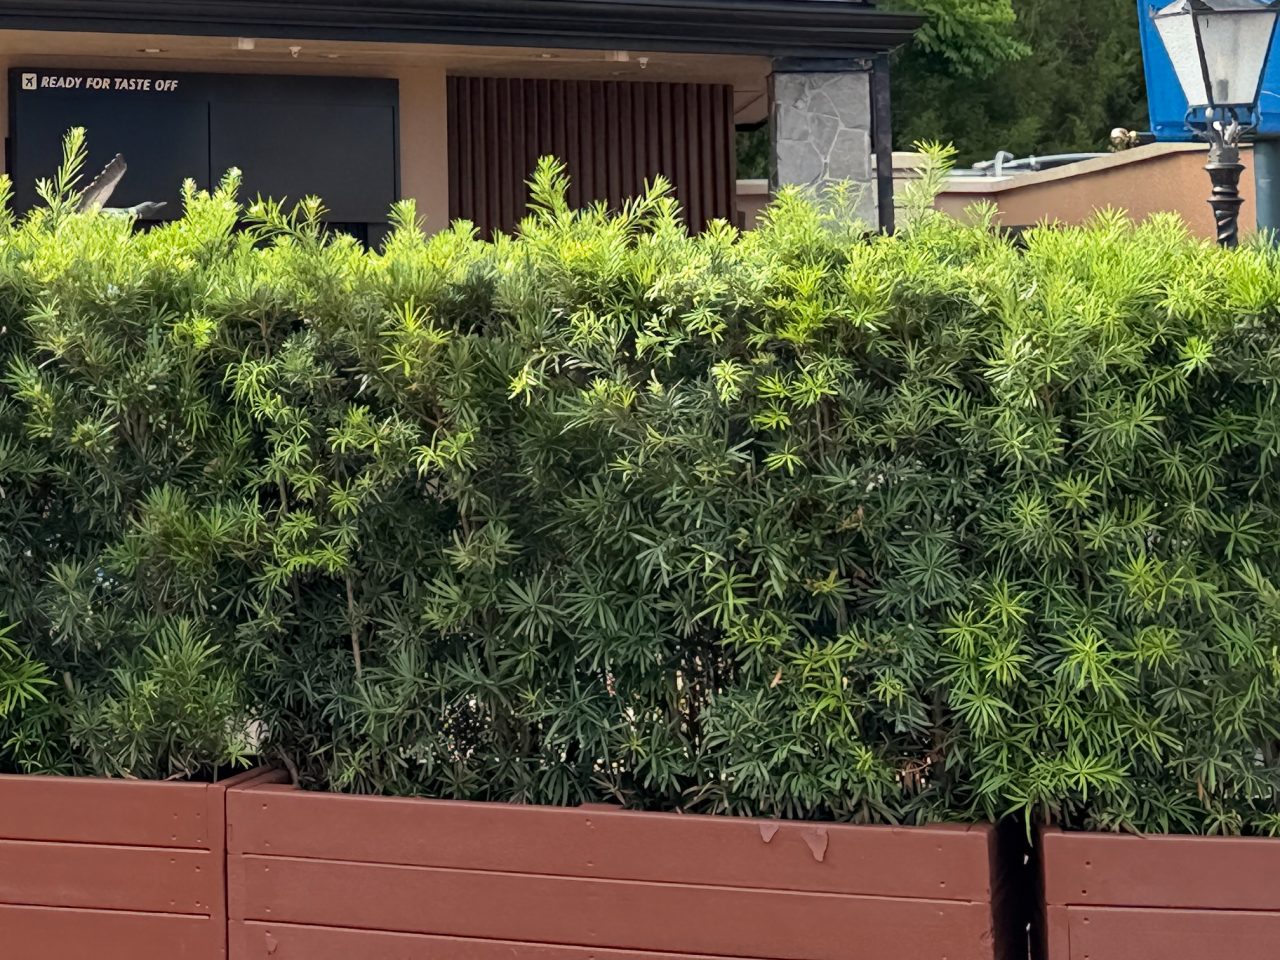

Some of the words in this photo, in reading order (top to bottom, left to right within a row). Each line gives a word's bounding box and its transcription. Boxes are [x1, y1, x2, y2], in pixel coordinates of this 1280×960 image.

[40, 76, 83, 89] READY
[86, 77, 111, 90] FOR
[114, 78, 152, 91] TASTE
[154, 79, 179, 92] OFF
